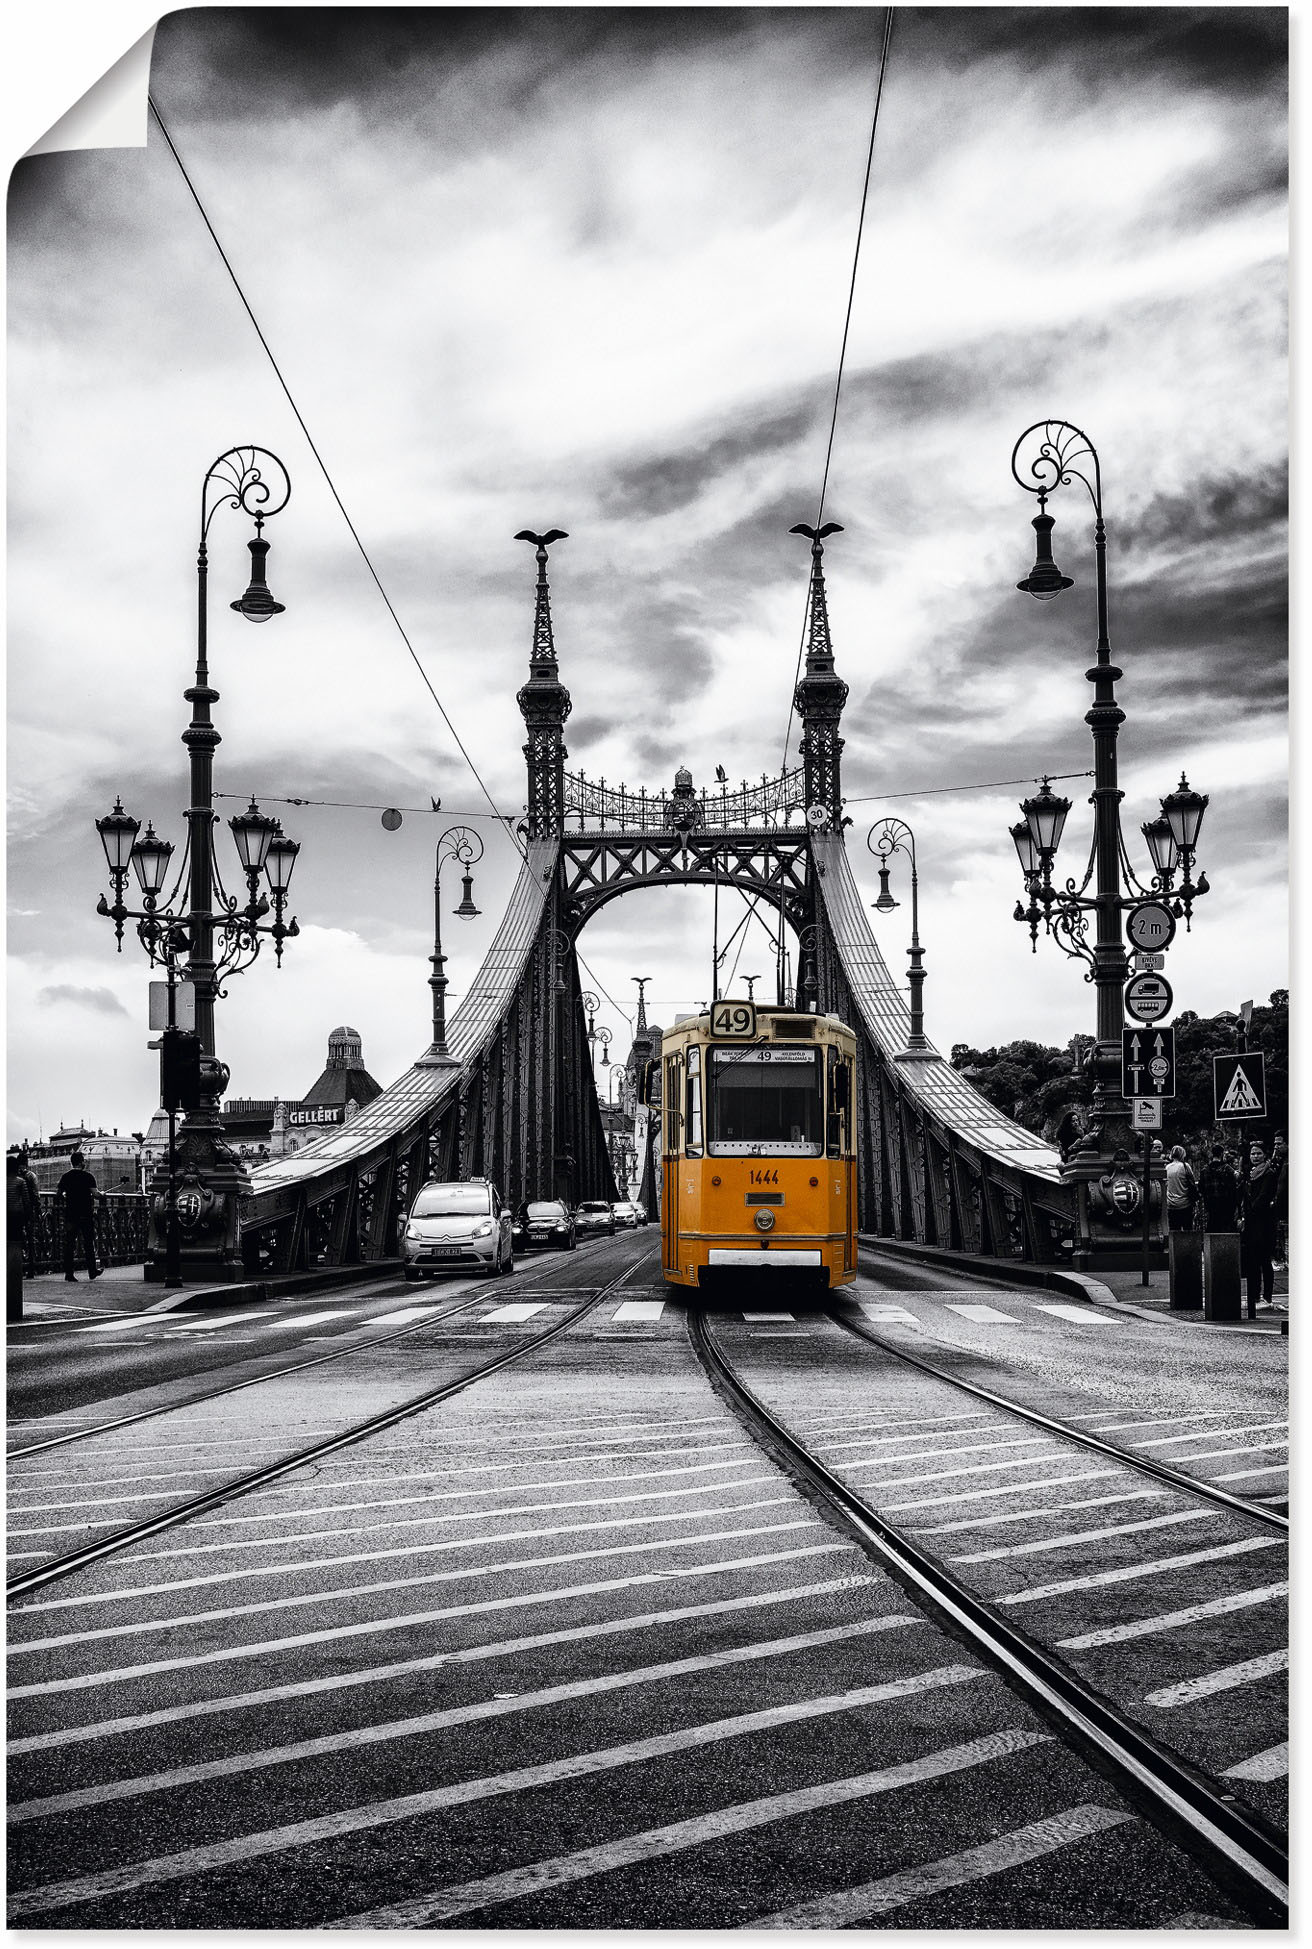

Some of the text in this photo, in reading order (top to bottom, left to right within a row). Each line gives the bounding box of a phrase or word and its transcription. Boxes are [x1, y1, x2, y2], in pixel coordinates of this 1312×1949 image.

[810, 809, 822, 820] 30
[1139, 919, 1162, 935] 2 m
[715, 1008, 750, 1033] 49
[757, 1051, 772, 1061] 49
[290, 1106, 339, 1124] GELLÉRT
[750, 1169, 779, 1185] 1444
